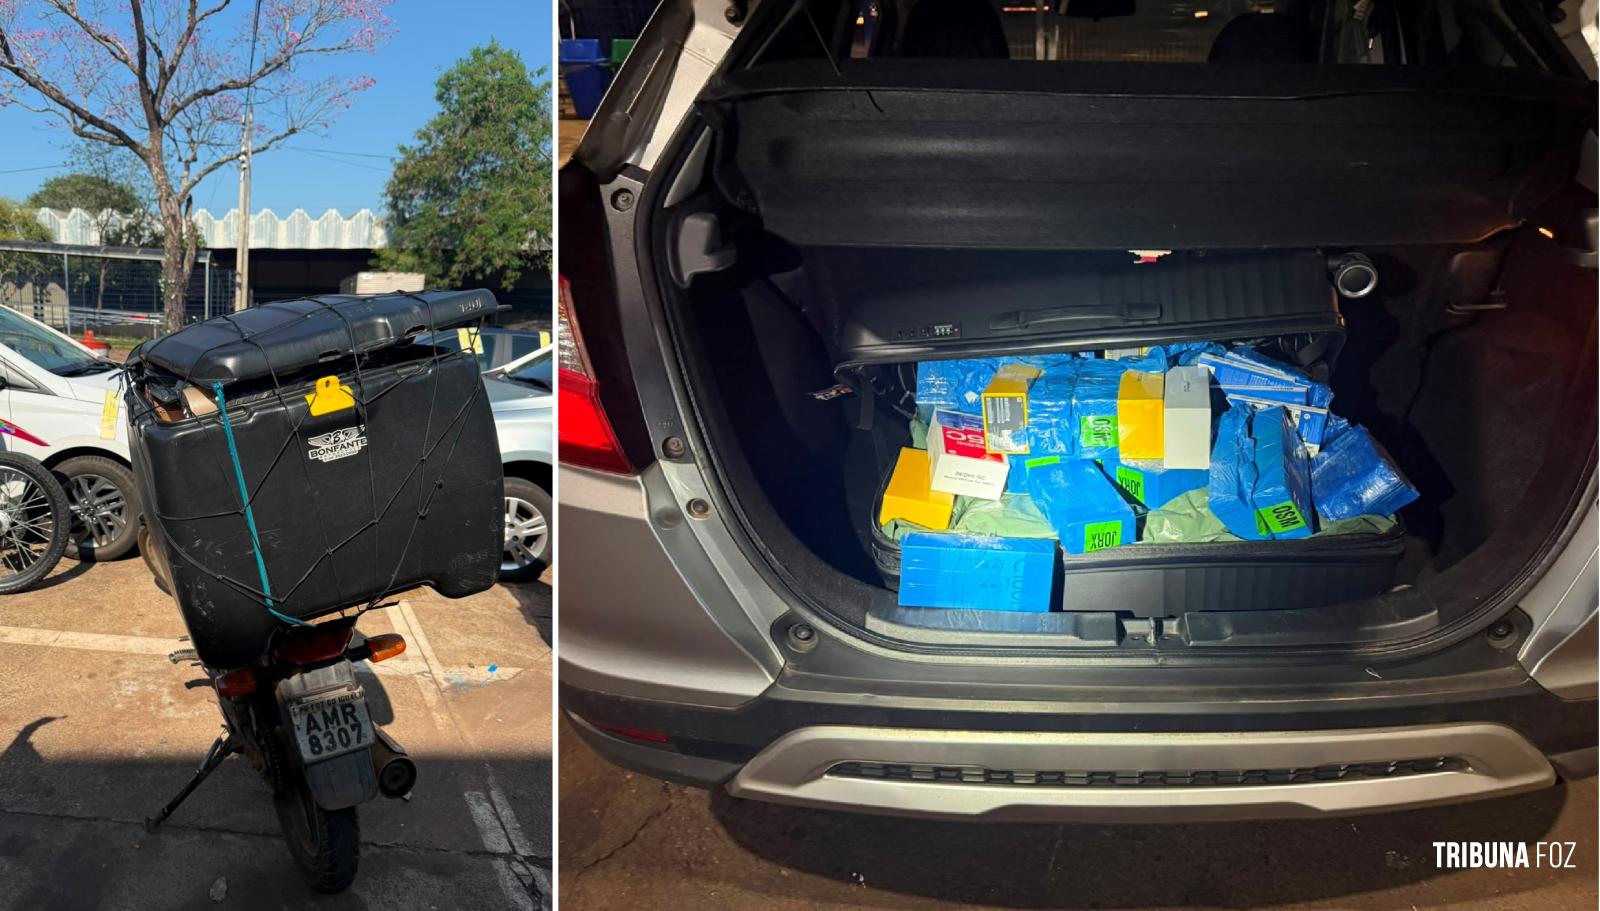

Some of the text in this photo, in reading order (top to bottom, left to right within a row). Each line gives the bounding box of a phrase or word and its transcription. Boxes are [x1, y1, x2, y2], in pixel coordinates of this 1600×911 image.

[310, 438, 368, 458] BONFANTE
[1118, 475, 1141, 497] JORX
[1272, 505, 1300, 528] OSM
[1091, 531, 1117, 549] JORX
[306, 703, 359, 735] AMR
[308, 722, 362, 755] 8307
